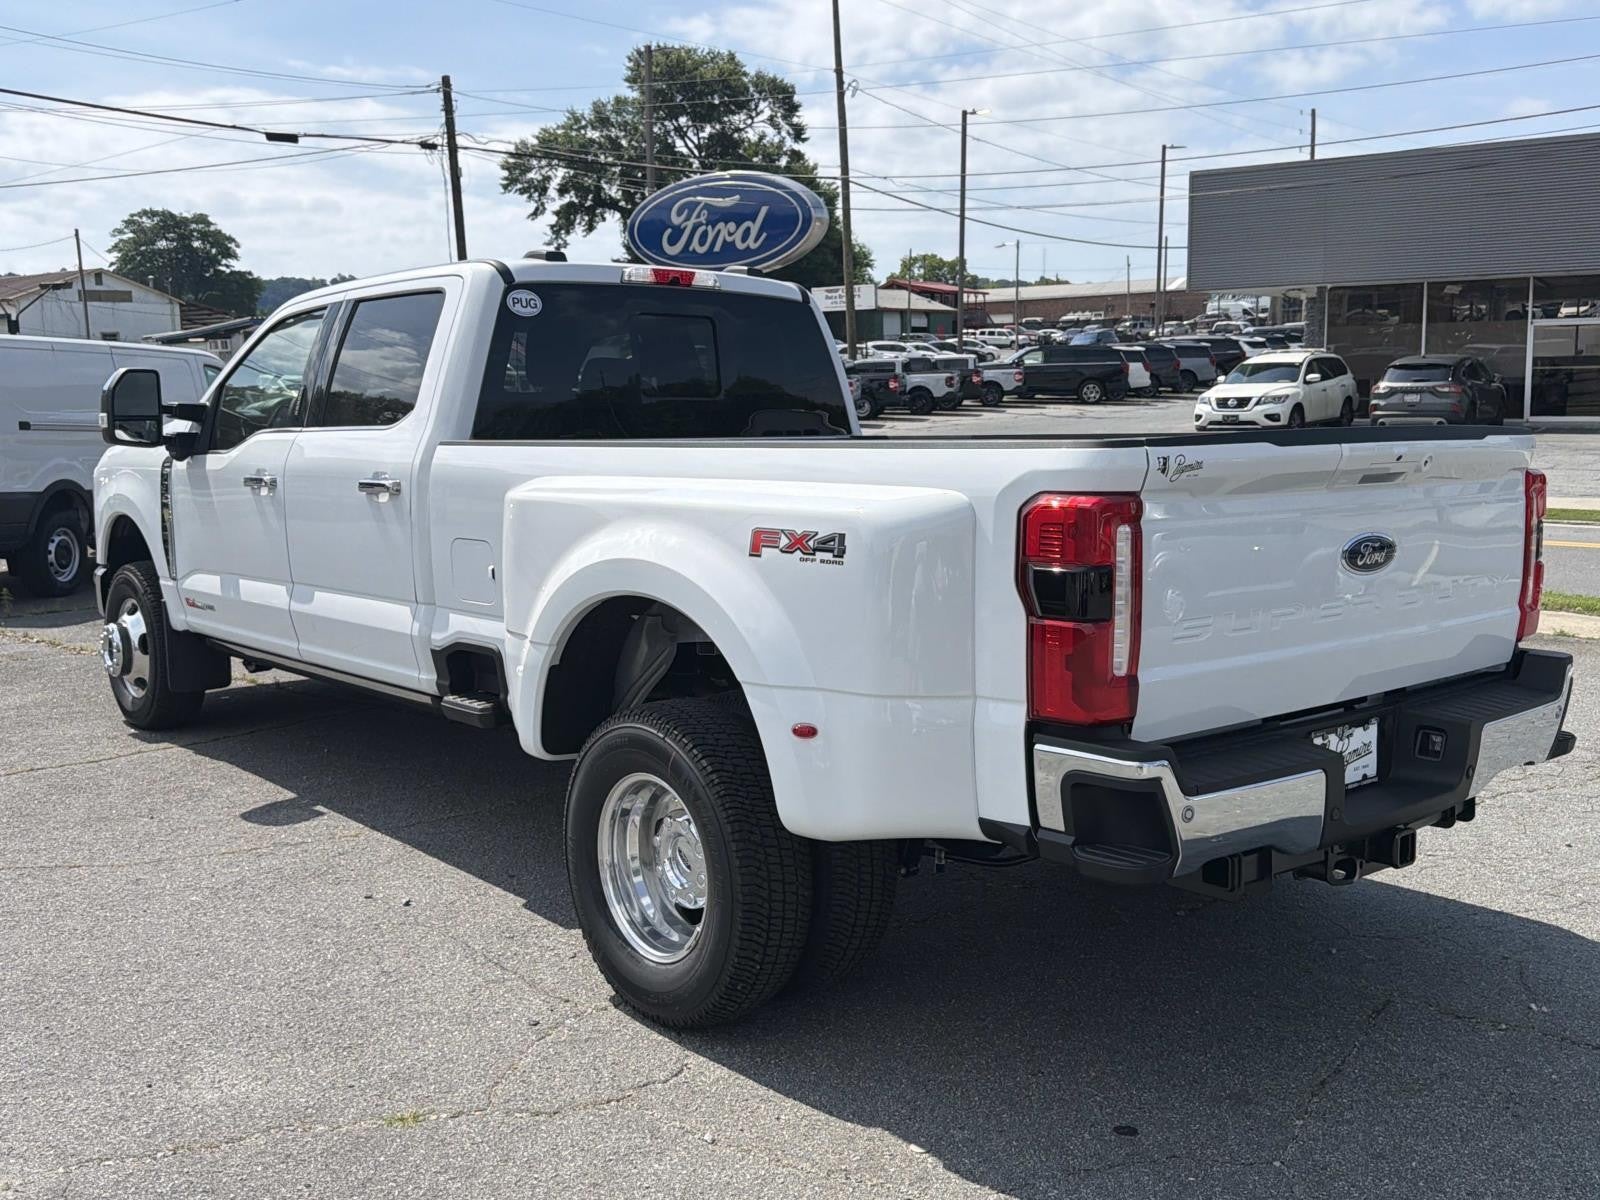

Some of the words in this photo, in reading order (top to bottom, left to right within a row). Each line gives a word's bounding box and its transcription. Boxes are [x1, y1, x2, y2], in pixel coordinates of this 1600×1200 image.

[662, 194, 770, 256] Ford
[511, 296, 538, 309] PUG
[748, 527, 847, 558] FX4
[1357, 542, 1387, 566] Ford
[819, 558, 845, 566] ROAD
